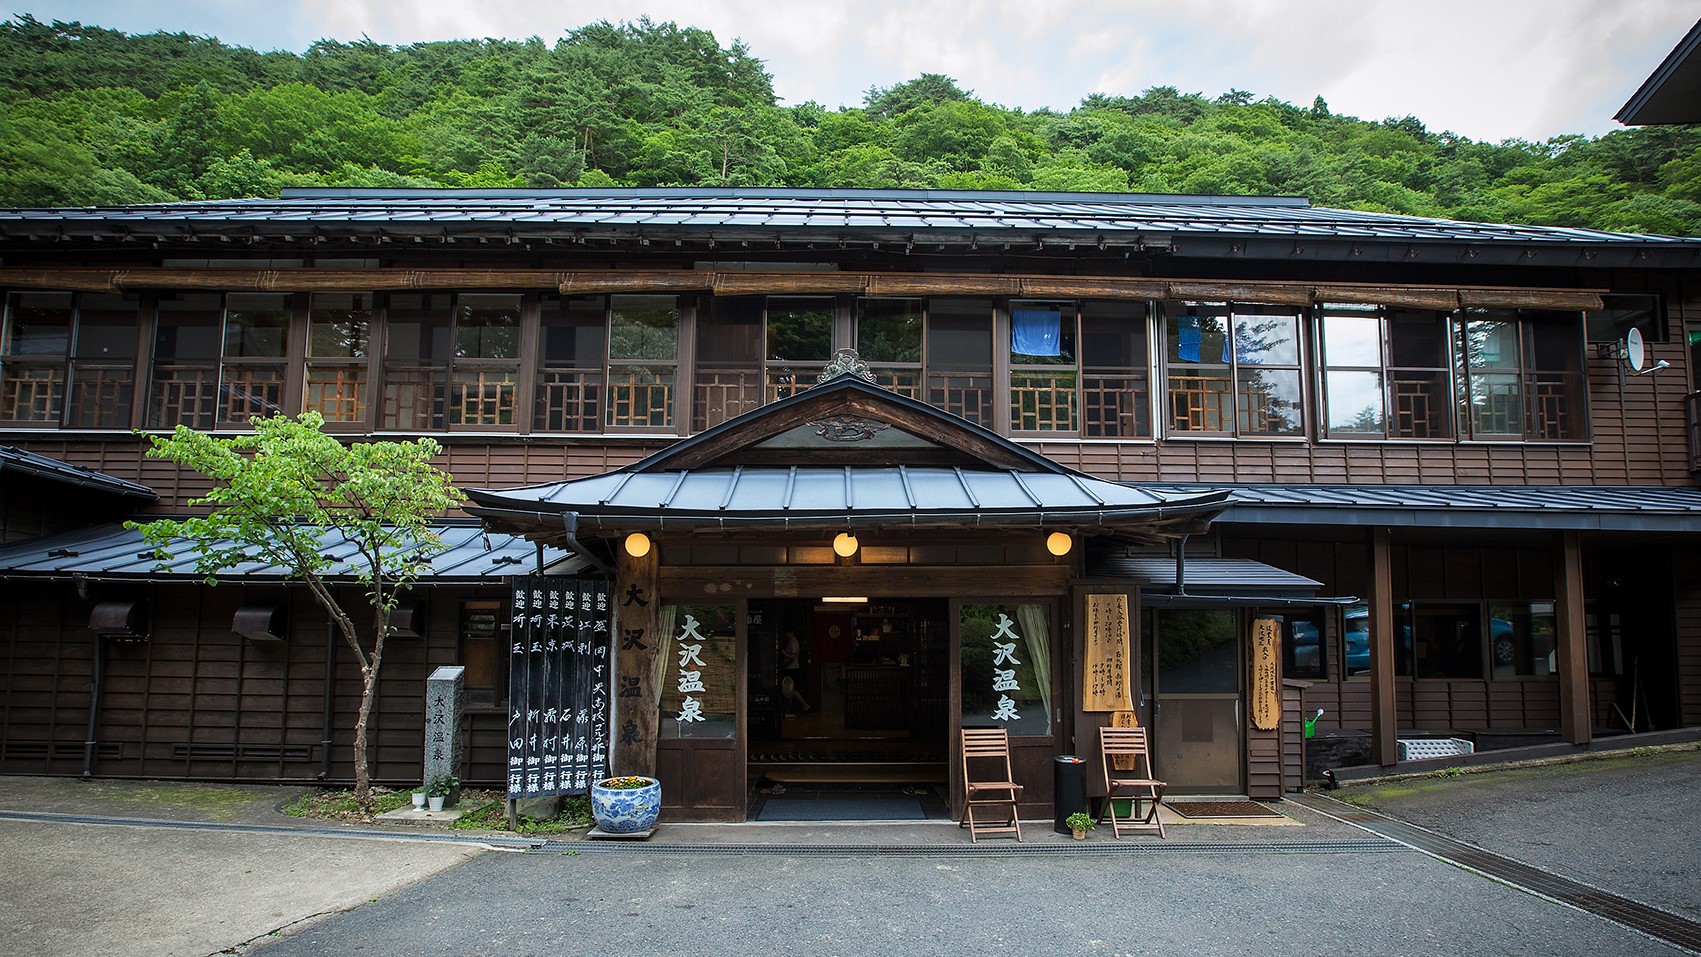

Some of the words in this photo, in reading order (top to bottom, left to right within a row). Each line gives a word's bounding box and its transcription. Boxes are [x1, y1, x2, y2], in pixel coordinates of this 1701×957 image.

[619, 584, 648, 745] 大沢温泉
[675, 614, 707, 723] 大沢温泉
[990, 613, 1022, 722] 大沢温泉
[433, 695, 446, 761] 大沢温泉
